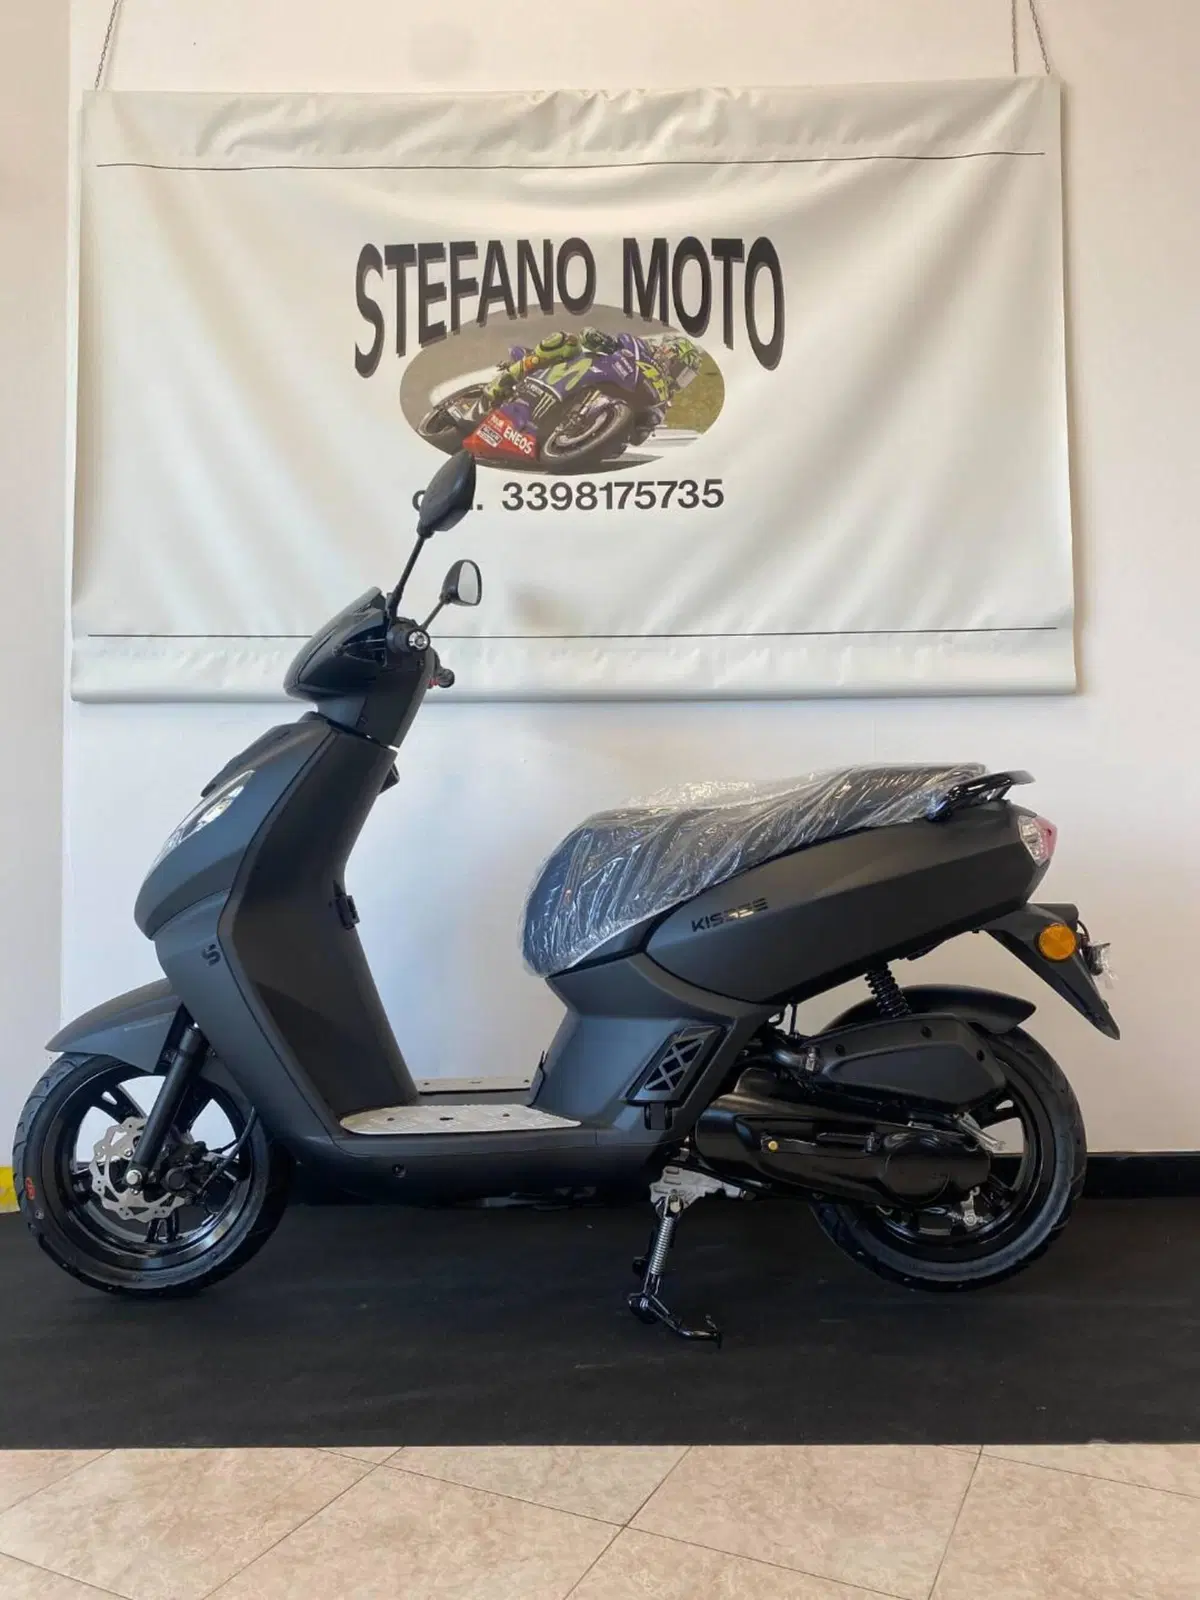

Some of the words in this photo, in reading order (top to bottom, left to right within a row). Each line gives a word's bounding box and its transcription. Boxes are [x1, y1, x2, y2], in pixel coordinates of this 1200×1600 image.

[354, 236, 597, 379] STEFANO
[623, 235, 786, 371] MOTO
[502, 426, 534, 454] ENEOS
[501, 479, 725, 511] 3398175735
